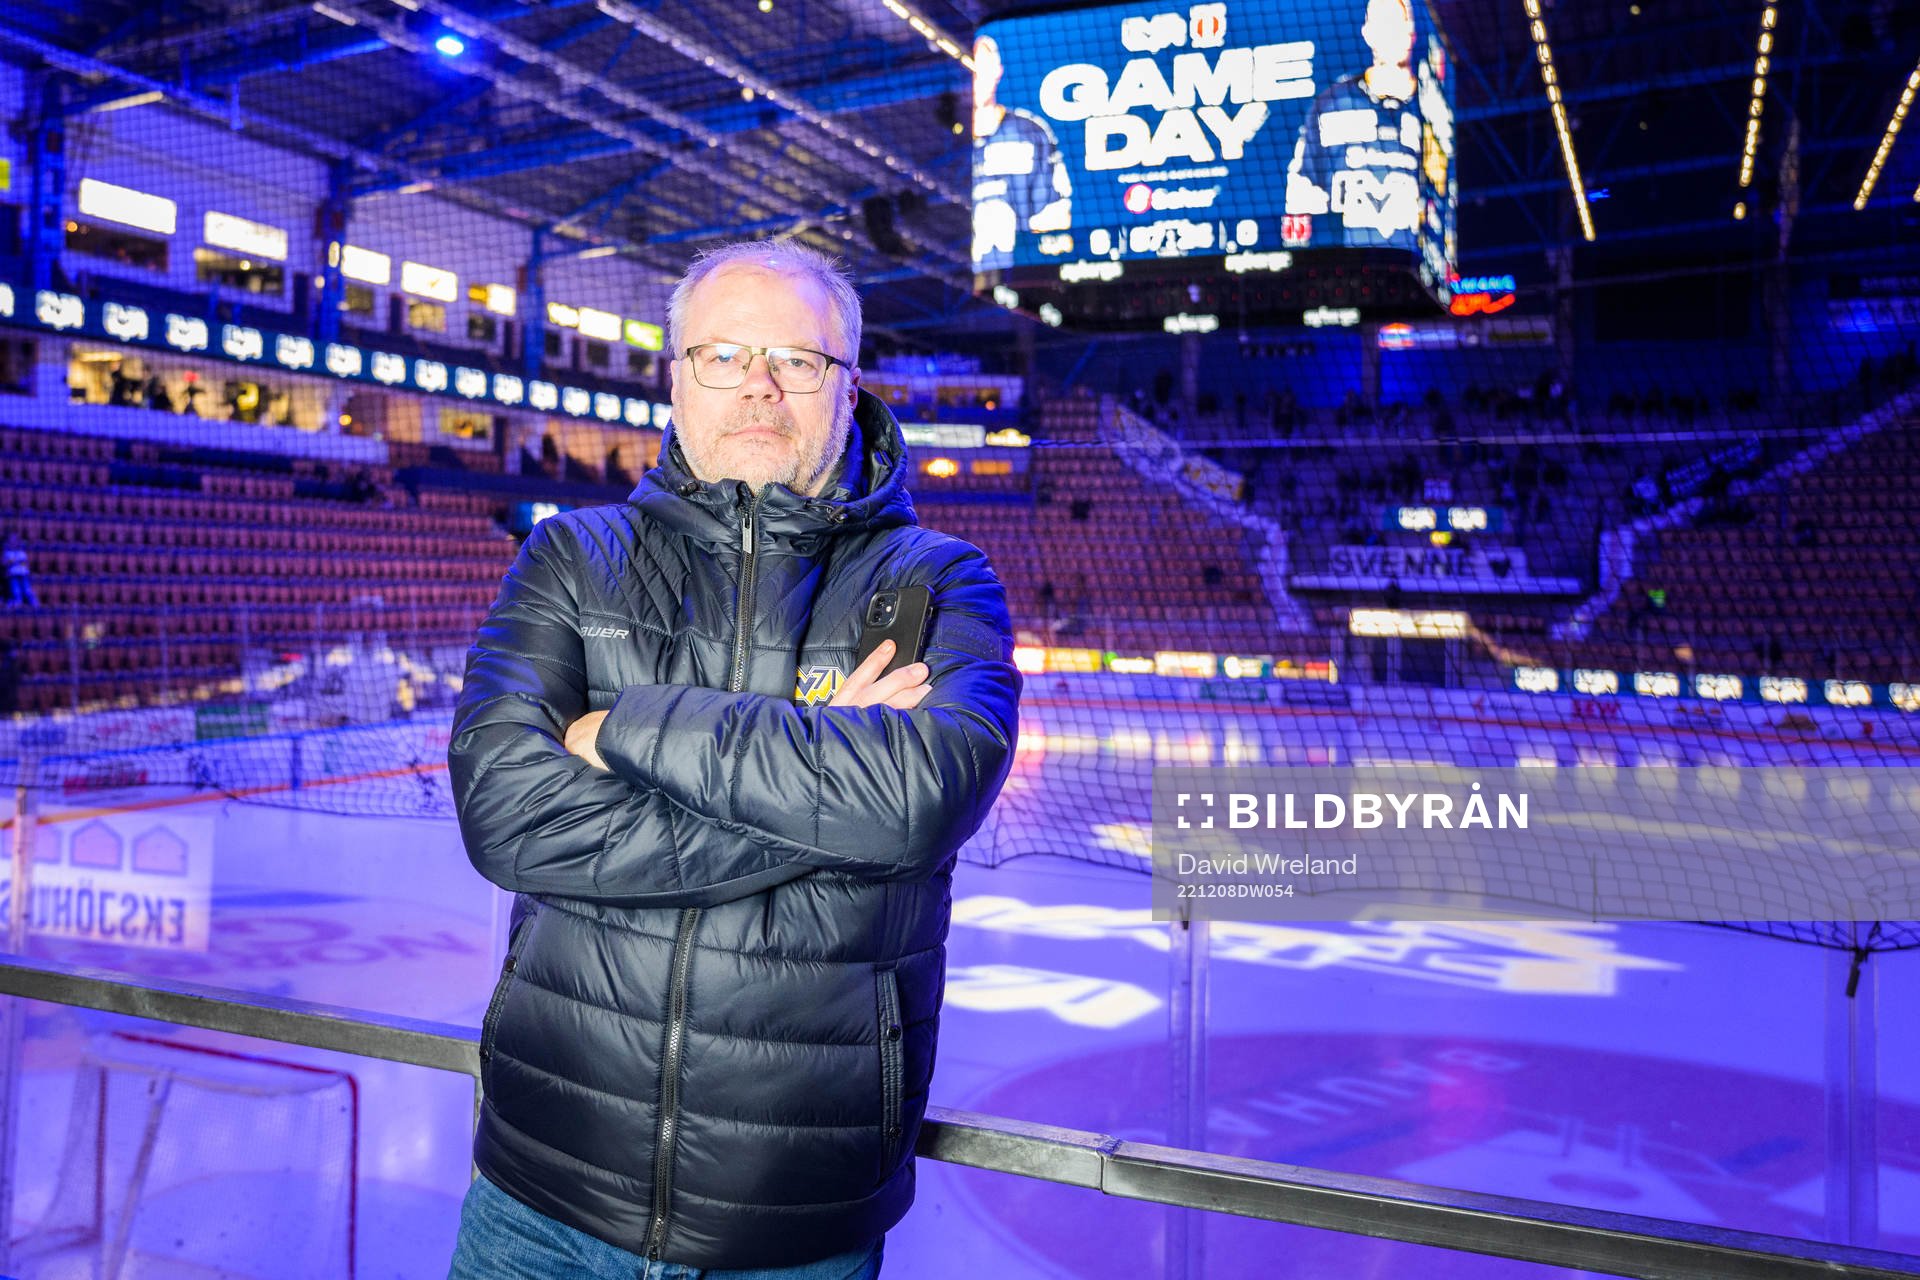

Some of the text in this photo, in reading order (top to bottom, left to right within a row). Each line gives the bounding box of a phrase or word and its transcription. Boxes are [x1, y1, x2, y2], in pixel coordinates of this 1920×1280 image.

[1040, 41, 1315, 121] GAME
[1084, 102, 1270, 171] DAY
[580, 626, 630, 640] AUER
